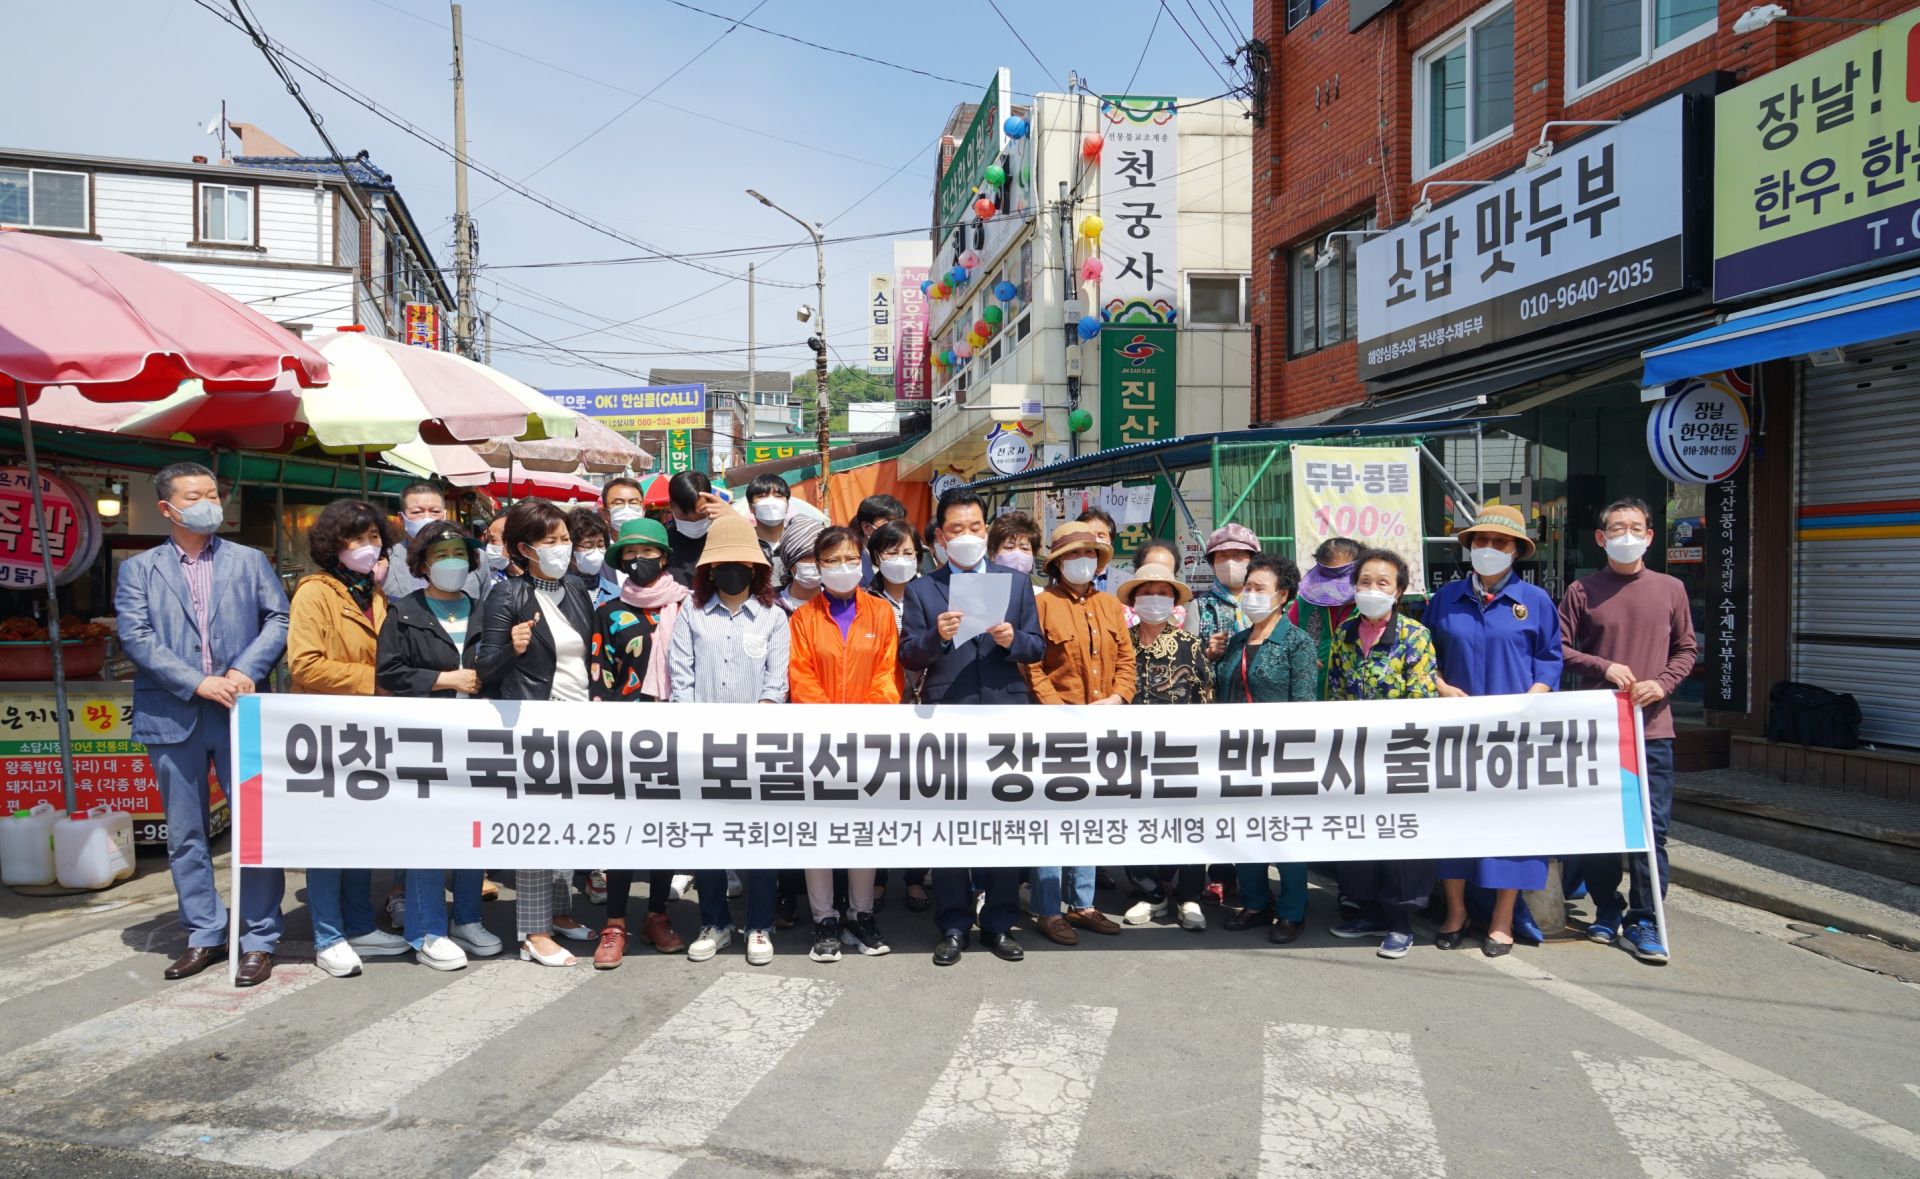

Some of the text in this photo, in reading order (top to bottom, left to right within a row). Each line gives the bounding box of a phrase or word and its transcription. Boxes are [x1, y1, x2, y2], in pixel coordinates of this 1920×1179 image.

[1756, 48, 1882, 151] 장날!
[1754, 123, 1920, 231] 한우.한
[1114, 149, 1164, 292] 천궁사
[1386, 143, 1620, 308] 소답 맛두부
[1519, 258, 1654, 321] 010-9640-2035
[1367, 315, 1484, 365] 해양심층수와 국산콩수제두부
[594, 394, 618, 409] OK!
[621, 390, 699, 409] 안심콜(CALL)
[1694, 402, 1726, 420] 장날
[1680, 422, 1739, 441] 한우한돈
[1314, 504, 1406, 537] 100%
[1719, 480, 1737, 542] 국산콩이
[1668, 550, 1688, 558] CCTV
[1721, 546, 1734, 593] 어우러진
[96, 741, 128, 753] 전통의
[285, 719, 1599, 802] 의창구 국회의원 보궐선거에 장동화는 반드시 출마하라!
[6, 779, 62, 794] 돼지고기
[97, 778, 130, 793] (각종
[490, 822, 616, 846] 2022.4.25
[641, 820, 715, 849] 의창구
[722, 820, 819, 848] 국회의원
[827, 819, 922, 848] 보궐선거
[931, 818, 1050, 848] 시민대책위
[1059, 817, 1129, 847] 위원장
[1137, 817, 1206, 845] 정세영
[1214, 817, 1237, 843] 외
[1245, 815, 1314, 843] 의창구
[1321, 813, 1366, 841] 주민
[1375, 812, 1420, 839] 일동
